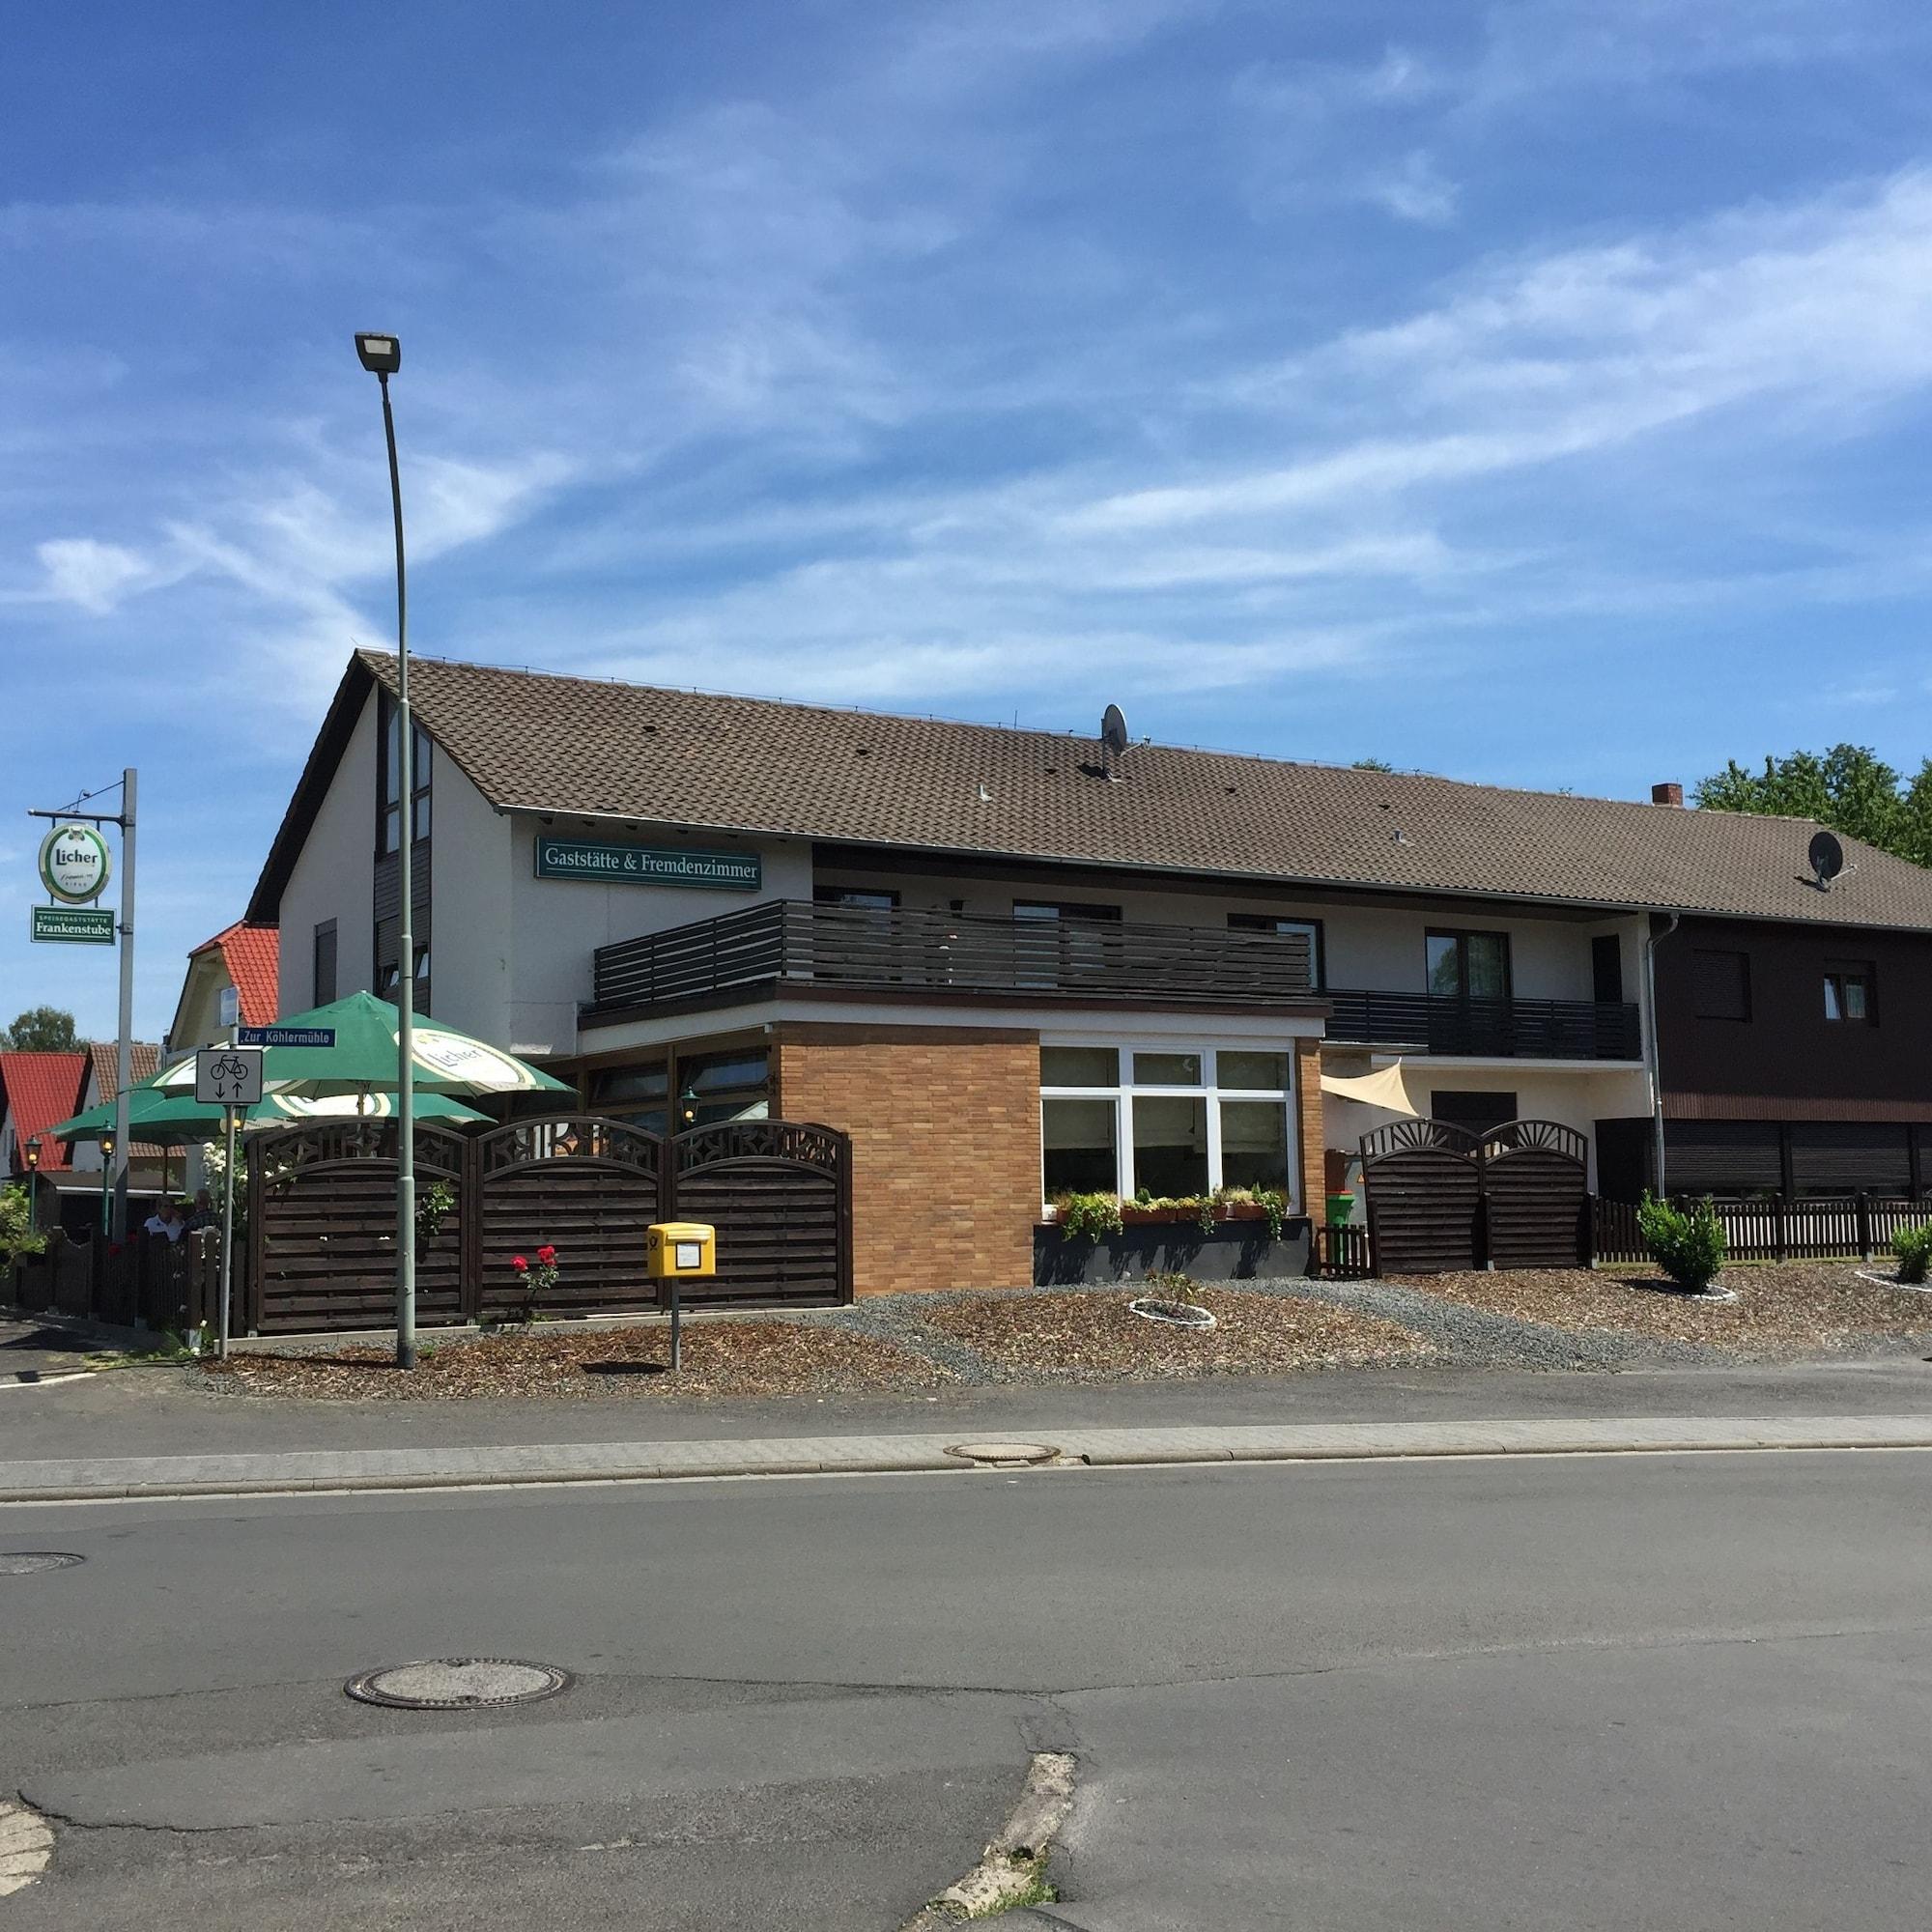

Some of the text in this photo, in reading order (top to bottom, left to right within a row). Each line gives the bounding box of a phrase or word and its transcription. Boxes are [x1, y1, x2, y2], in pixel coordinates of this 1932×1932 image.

[56, 848, 98, 866] Licher
[545, 847, 757, 878] Gaststätte & Fremdenzimmer
[36, 922, 111, 935] Frankenstube
[266, 1031, 329, 1043] Köhlermühle
[427, 1049, 482, 1067] Licher
